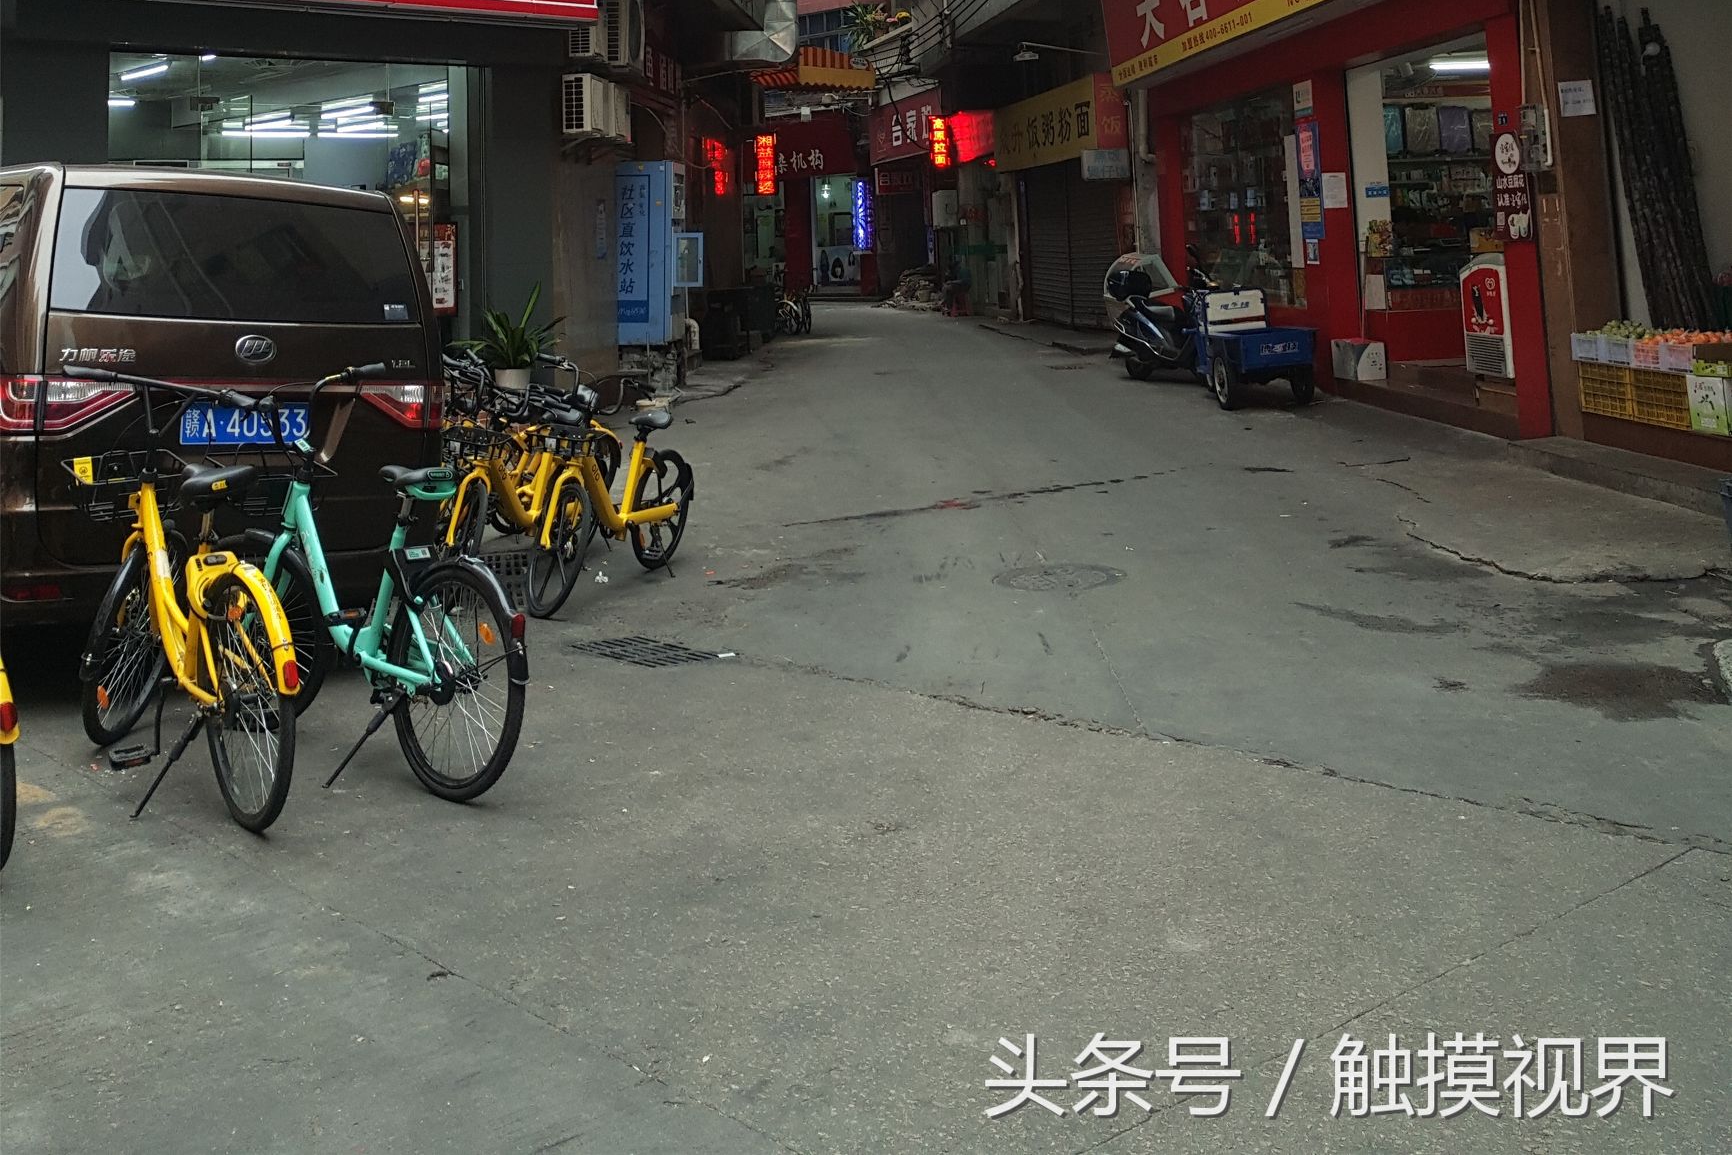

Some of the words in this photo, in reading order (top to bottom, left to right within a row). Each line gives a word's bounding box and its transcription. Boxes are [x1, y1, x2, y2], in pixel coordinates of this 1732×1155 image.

[932, 118, 947, 165] 高原拉面
[619, 184, 636, 294] 社区直饮水站
[59, 348, 136, 363] 力帆乐途
